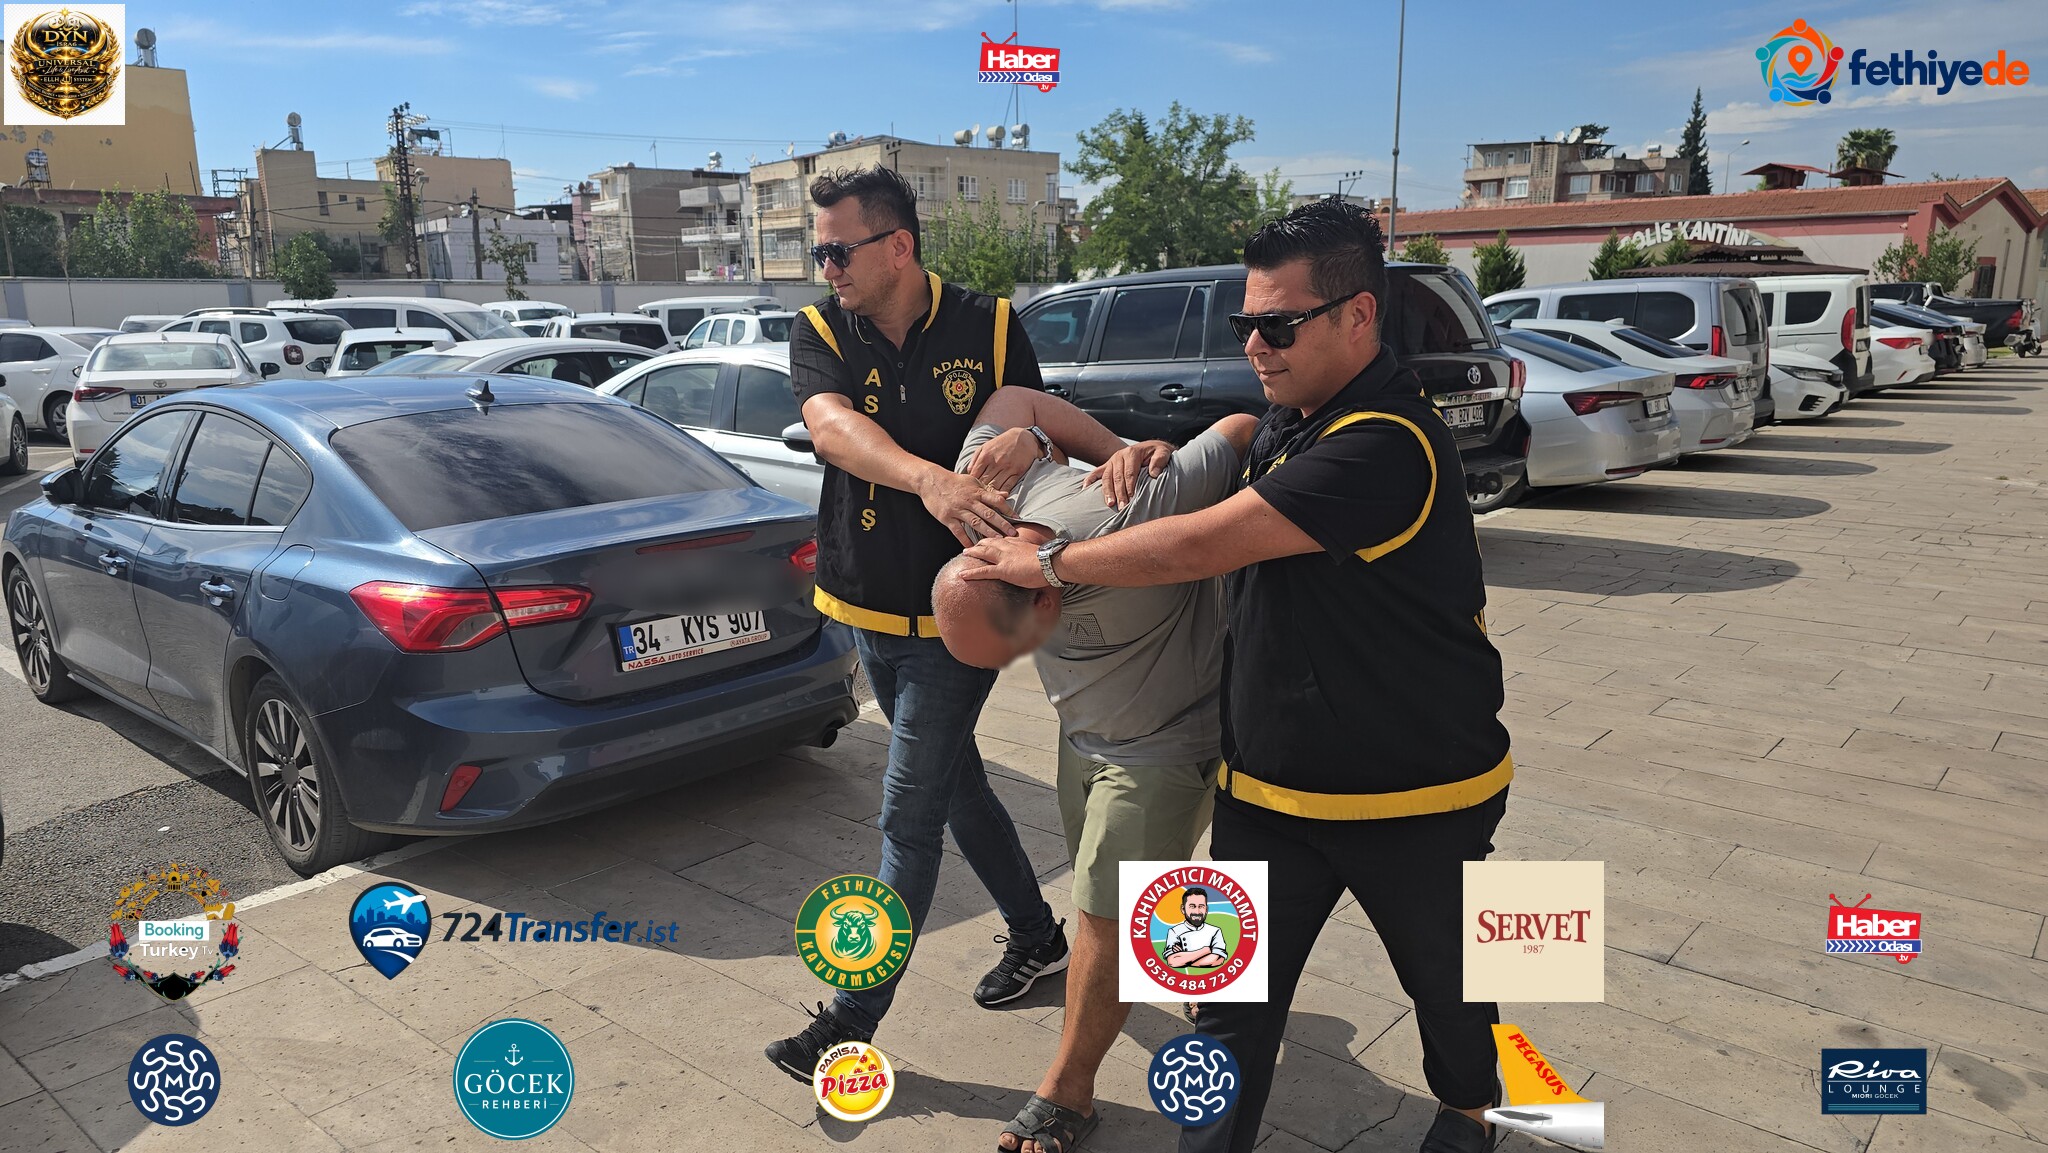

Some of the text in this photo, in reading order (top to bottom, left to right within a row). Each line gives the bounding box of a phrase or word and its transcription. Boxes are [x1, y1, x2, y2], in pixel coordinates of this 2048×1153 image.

[932, 358, 984, 379] ADANA
[136, 395, 147, 405] 01
[632, 624, 661, 655] 34
[680, 615, 720, 646] KYS
[623, 645, 635, 655] TR
[627, 656, 666, 670] NASSA
[667, 653, 682, 662] AUTO
[682, 647, 704, 658] SERVICE
